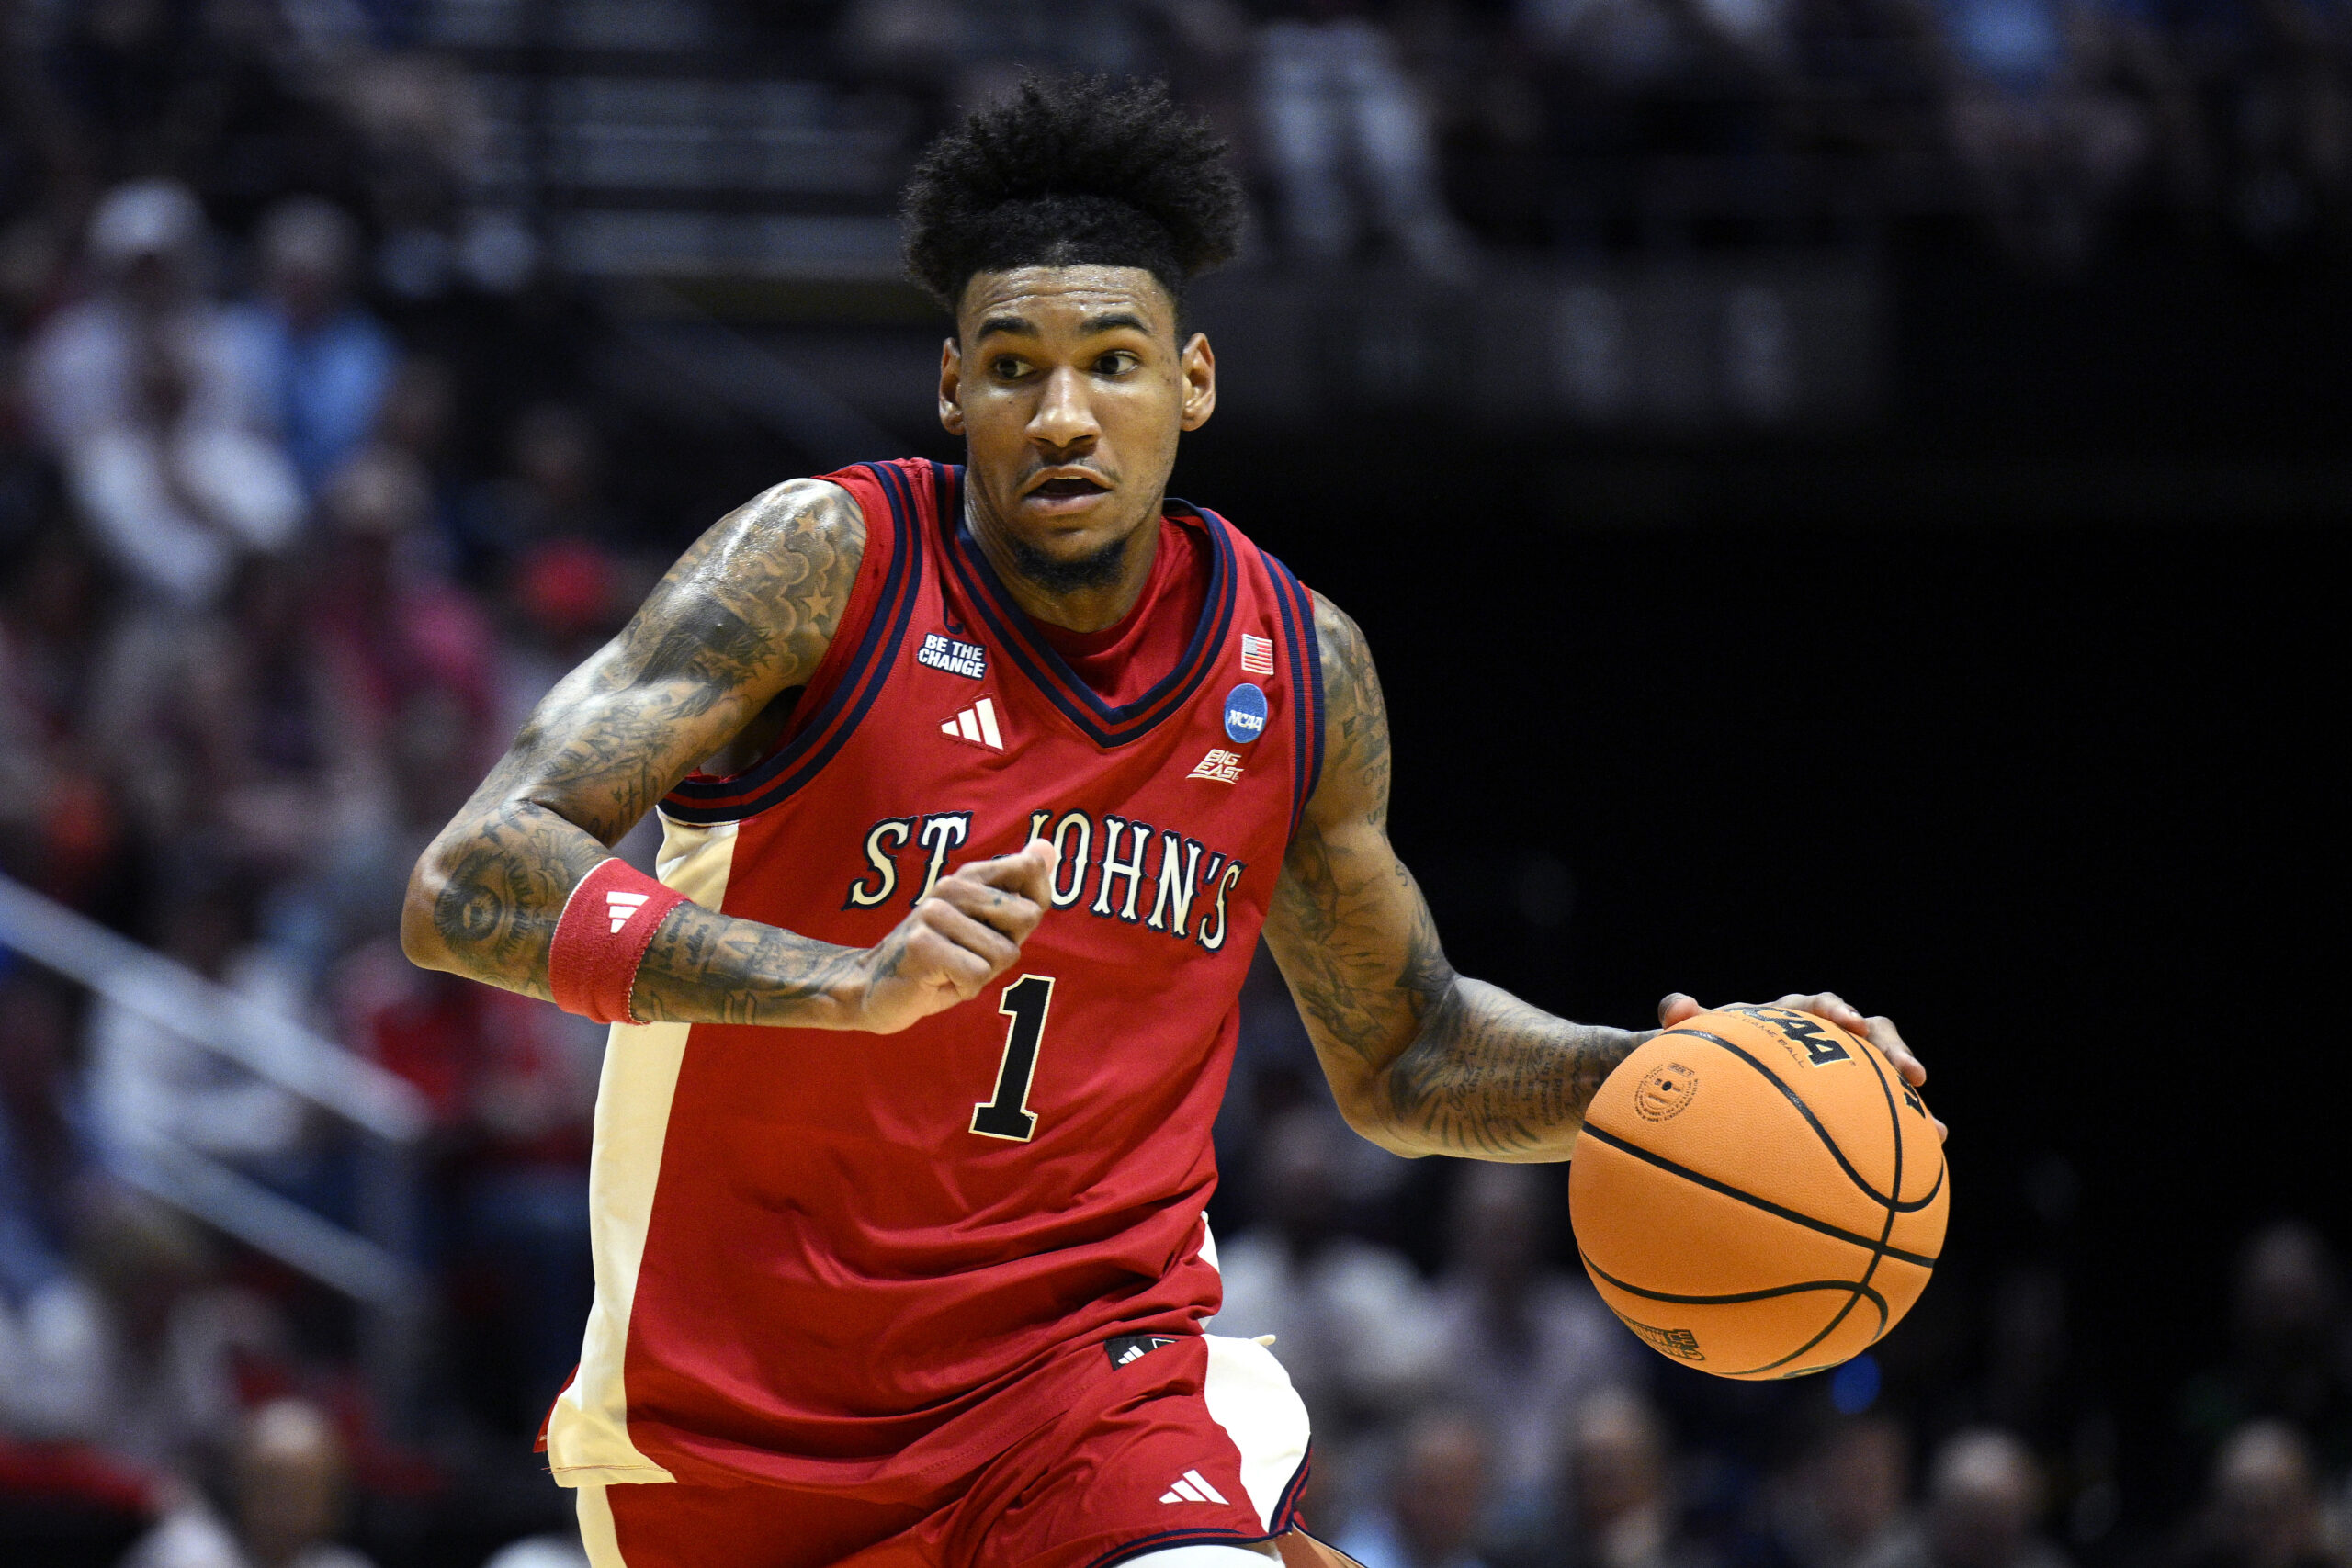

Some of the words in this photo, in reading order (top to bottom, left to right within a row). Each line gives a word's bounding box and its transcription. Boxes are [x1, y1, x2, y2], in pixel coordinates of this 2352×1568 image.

[924, 634, 947, 653] BE
[953, 637, 983, 661] THE
[918, 649, 986, 679] CHANGE
[1227, 708, 1264, 733] NCAA
[1202, 748, 1242, 766] BIG
[1192, 762, 1245, 782] EAST
[1724, 1006, 1852, 1067] CAA
[969, 973, 1056, 1143] 1
[1776, 1038, 1804, 1069] BALL
